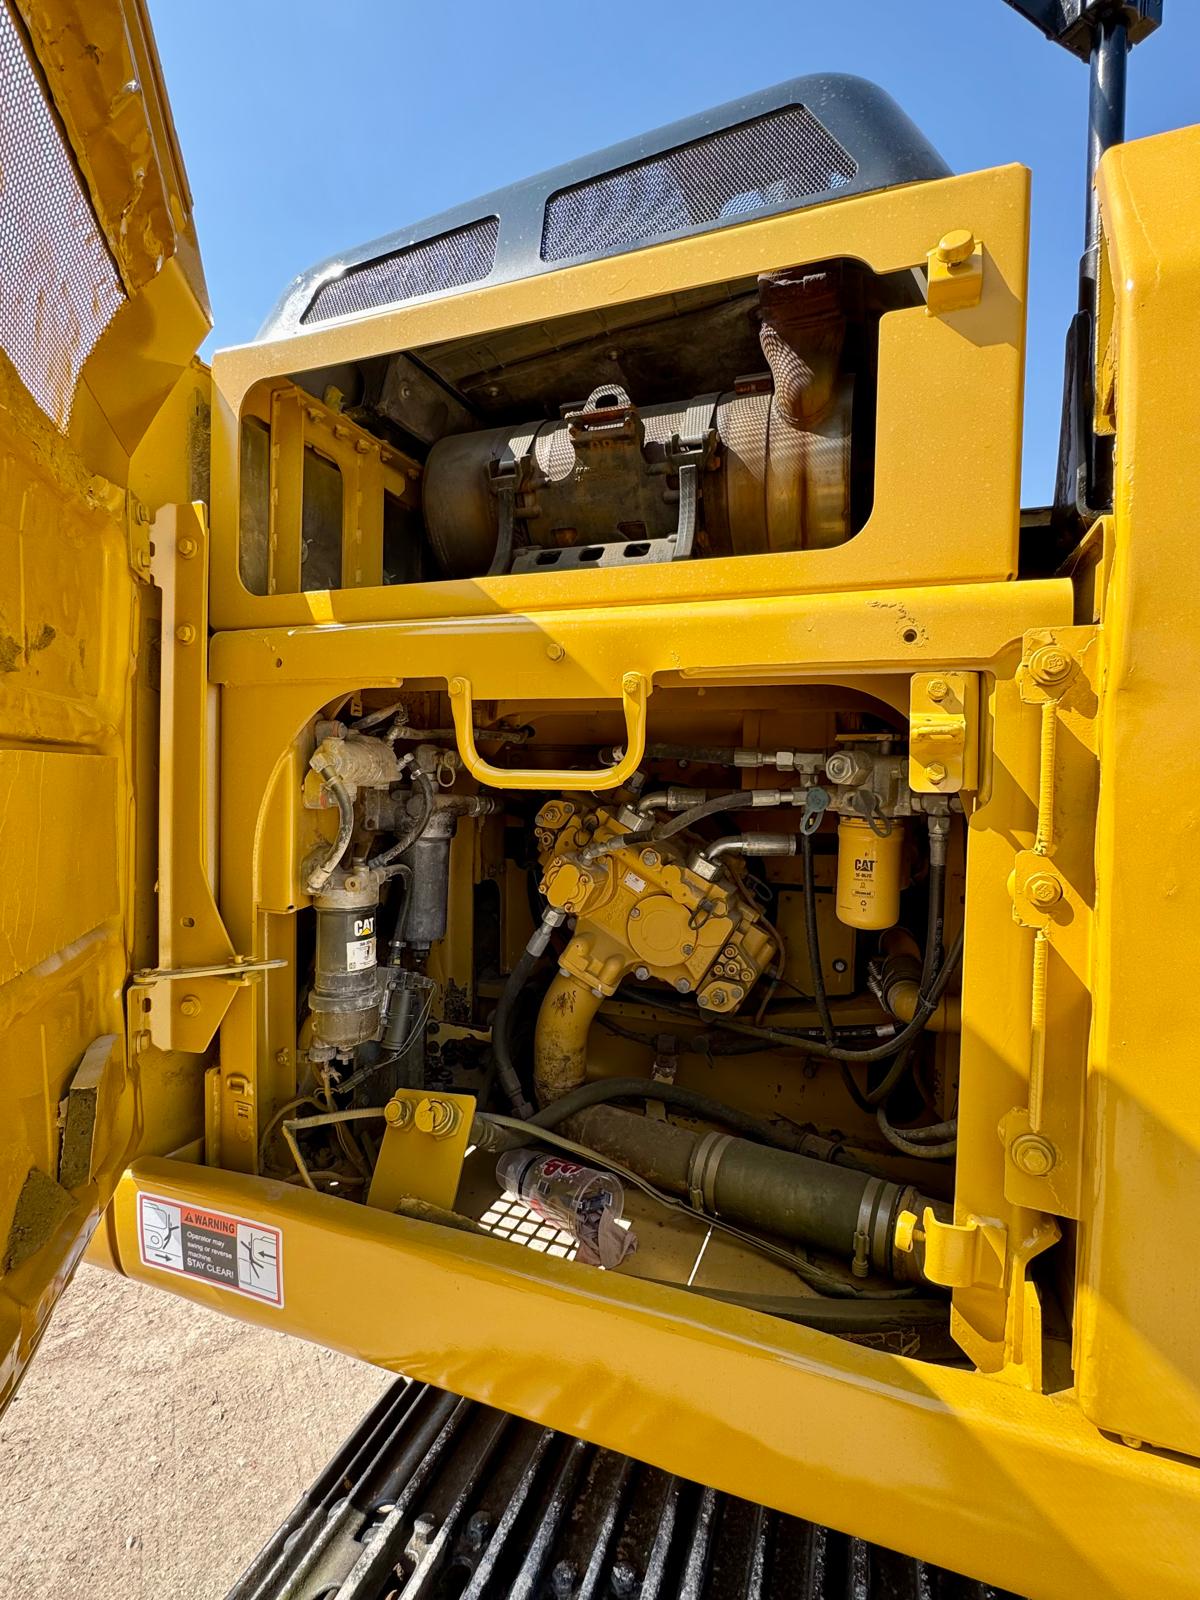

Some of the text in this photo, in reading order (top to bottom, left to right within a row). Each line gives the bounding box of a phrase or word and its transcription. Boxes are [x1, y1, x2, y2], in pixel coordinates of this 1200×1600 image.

[855, 859, 874, 872] CAT
[354, 917, 374, 937] CAT
[195, 1214, 234, 1233] WARNING
[187, 1231, 224, 1248] Operator may
[212, 1249, 232, 1259] reverse
[187, 1258, 233, 1279] STAY CLEAR!
